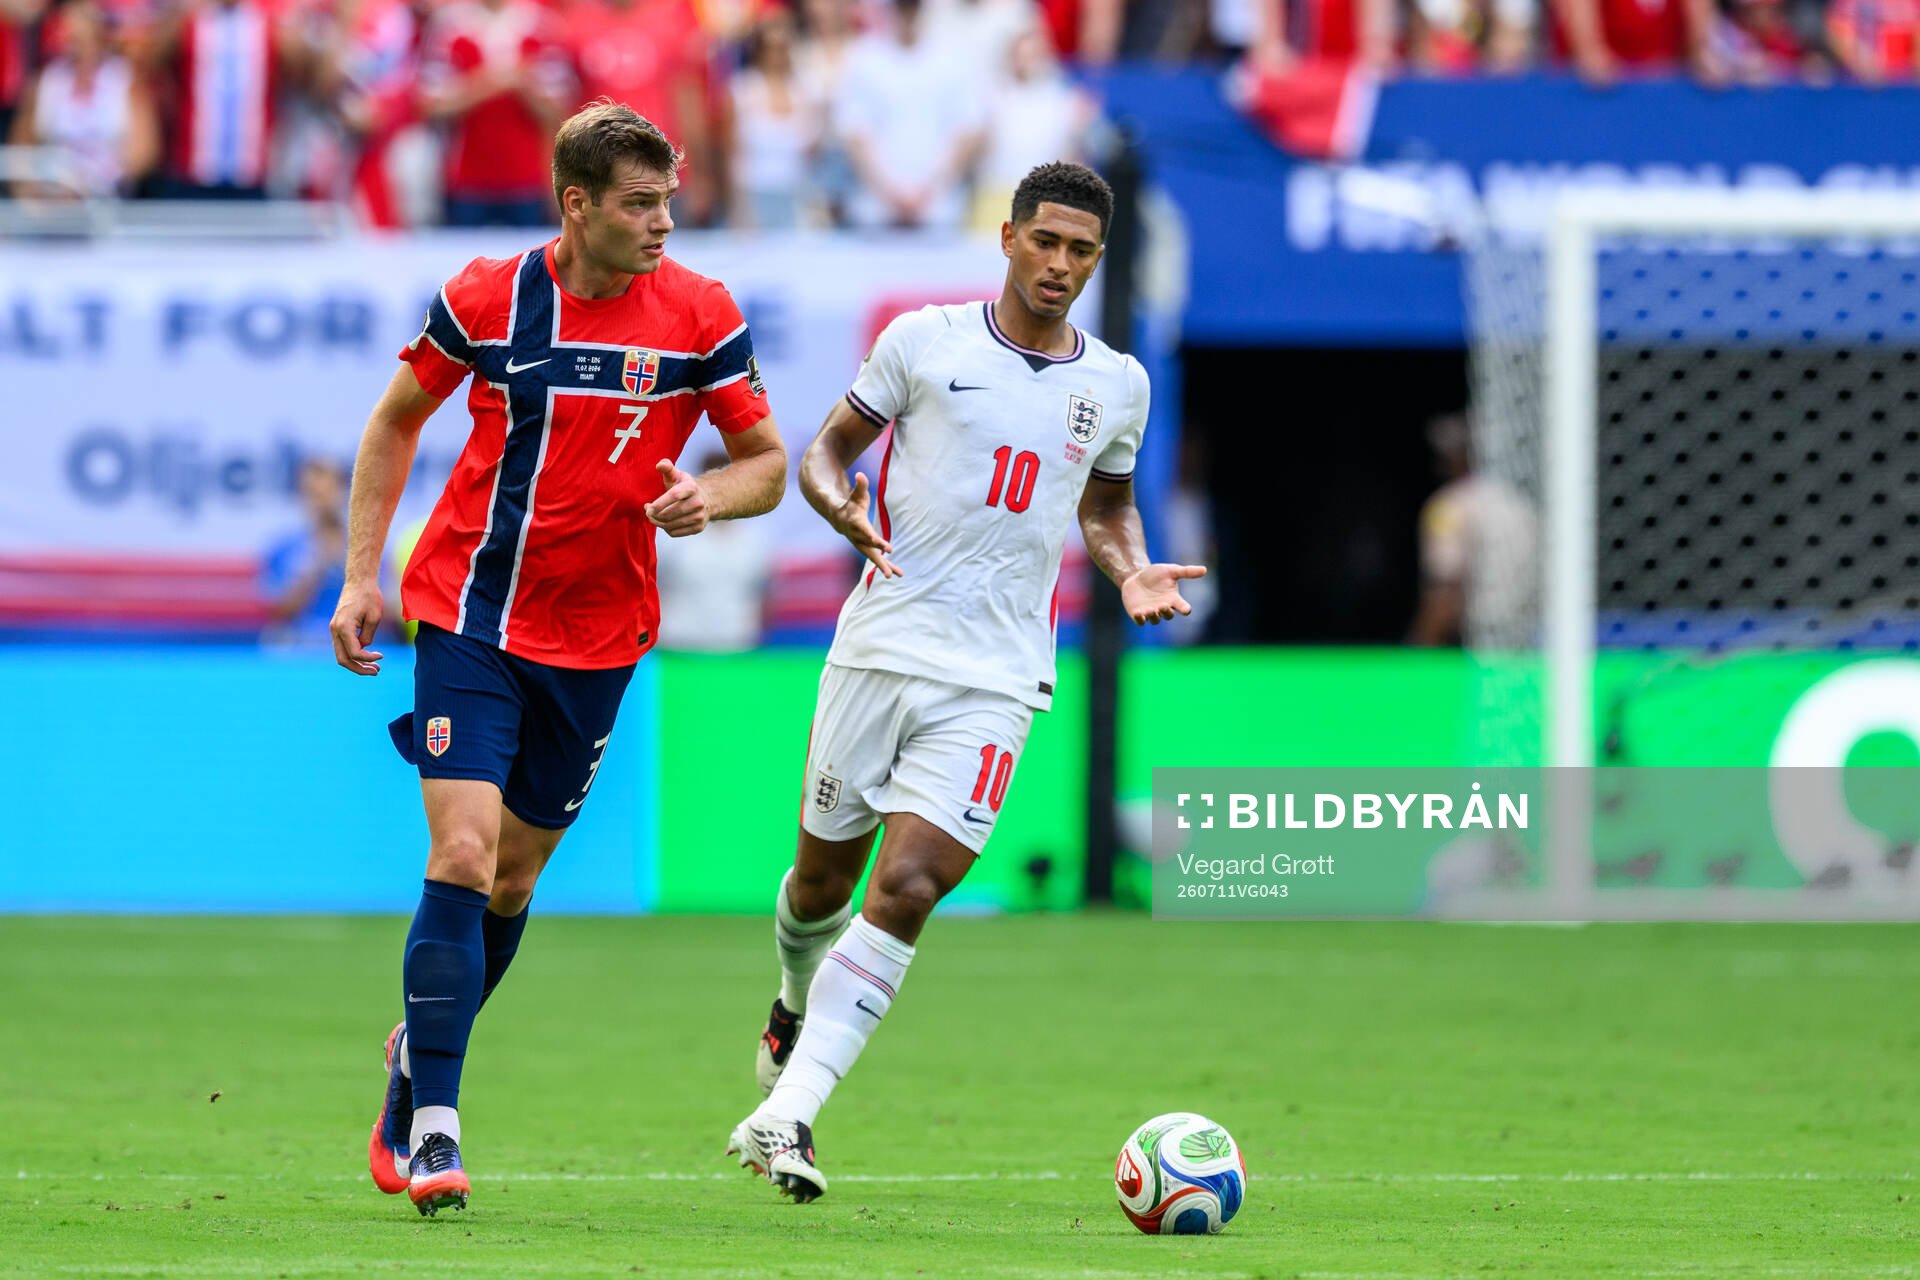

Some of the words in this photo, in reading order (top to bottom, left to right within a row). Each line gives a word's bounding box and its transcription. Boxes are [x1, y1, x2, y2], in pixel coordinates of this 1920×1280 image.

[608, 404, 649, 464] 7
[985, 445, 1041, 513] 10
[971, 743, 1013, 813] 10
